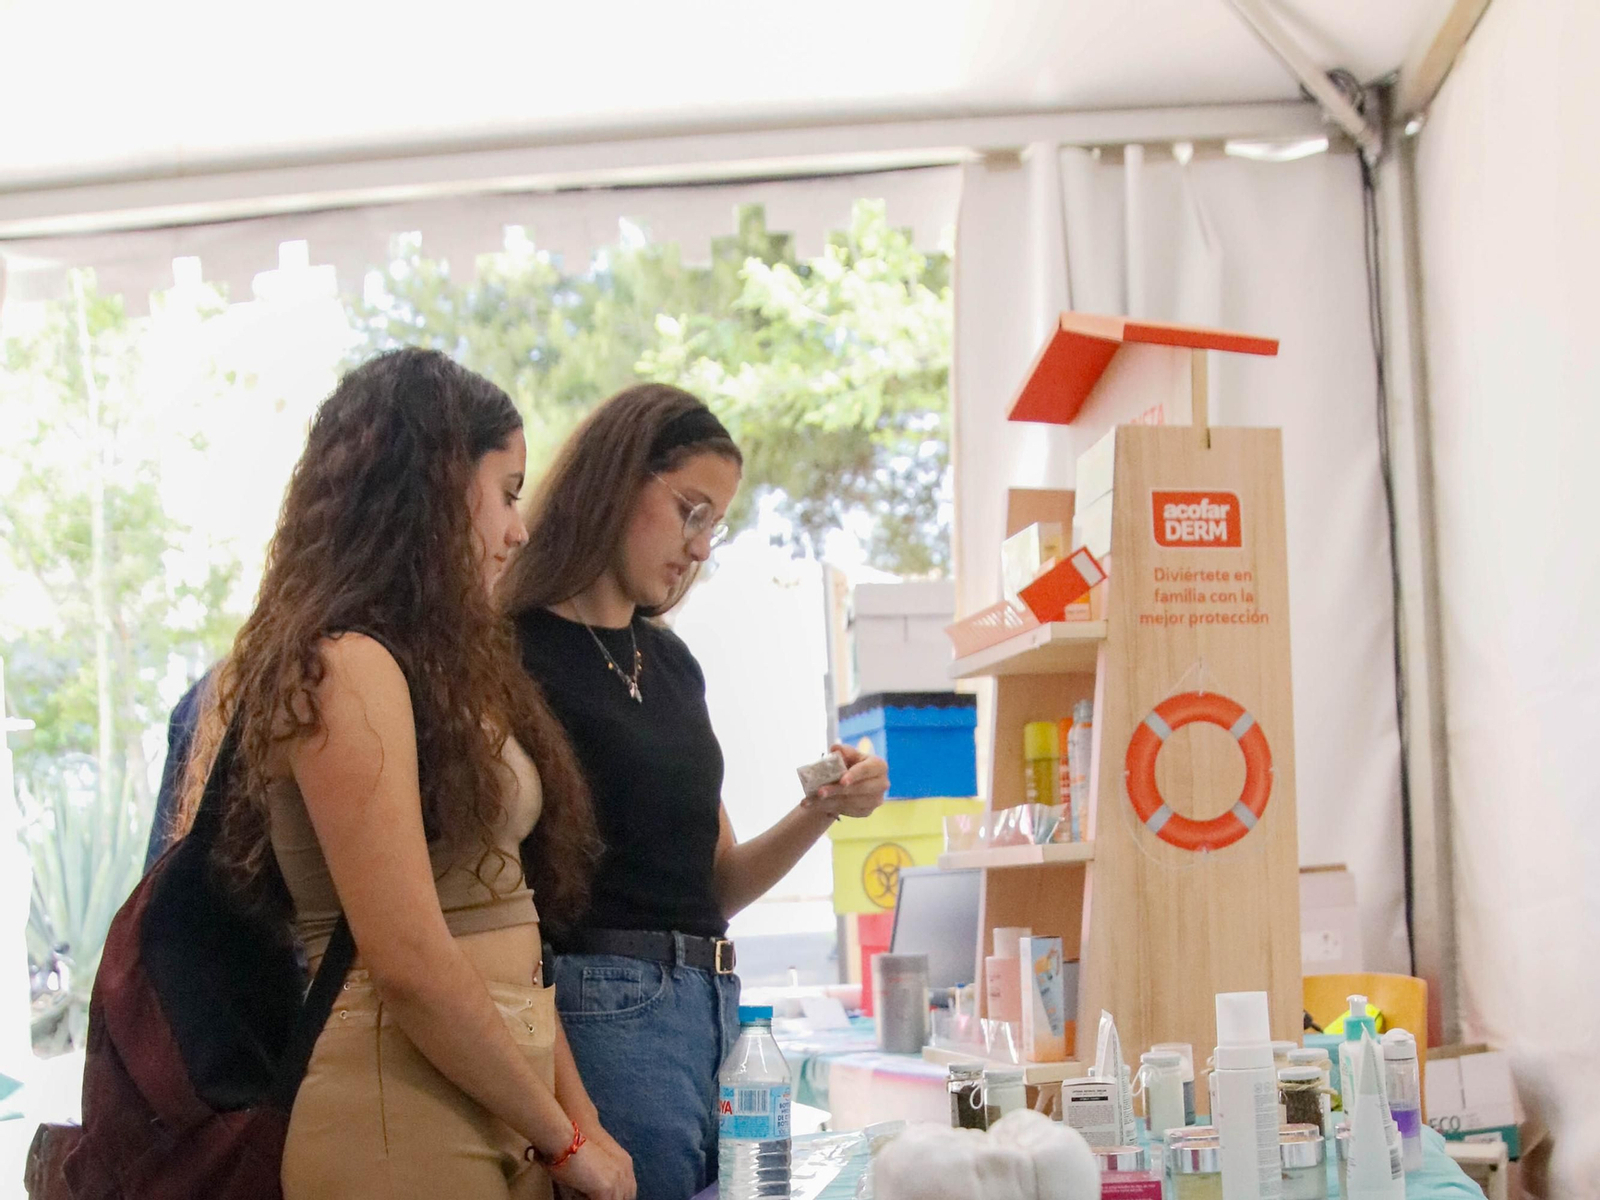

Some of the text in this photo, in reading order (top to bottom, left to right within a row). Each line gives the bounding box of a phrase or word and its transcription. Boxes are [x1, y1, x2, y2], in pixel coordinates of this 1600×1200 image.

[1163, 498, 1230, 519] acofar
[1165, 520, 1228, 541] DERM
[1154, 567, 1253, 582] Diviértete en
[1154, 588, 1254, 603] familia con la
[1139, 608, 1269, 628] mejor protección
